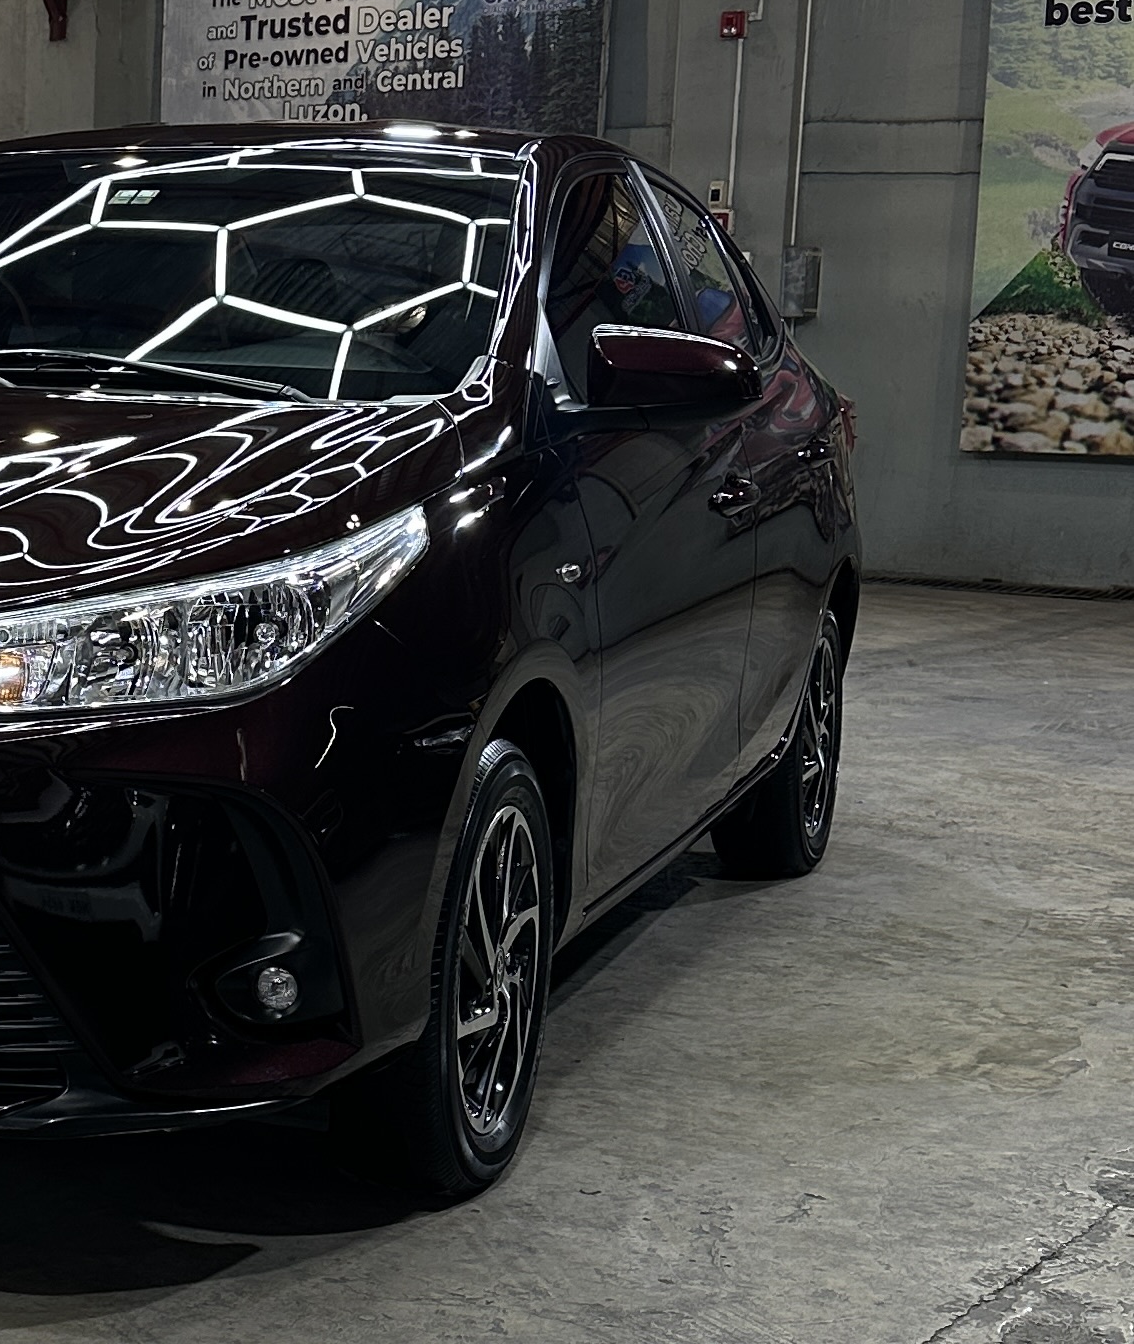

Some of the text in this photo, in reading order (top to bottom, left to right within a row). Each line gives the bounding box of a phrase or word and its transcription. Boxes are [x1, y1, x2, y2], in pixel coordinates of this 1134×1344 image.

[207, 21, 237, 41] and
[240, 6, 350, 41] Trusted
[357, 2, 454, 35] Dealer
[197, 34, 464, 71] of Pre-owned Vehicles
[202, 65, 465, 101] in Northern and Central
[283, 101, 369, 122] Luzon.
